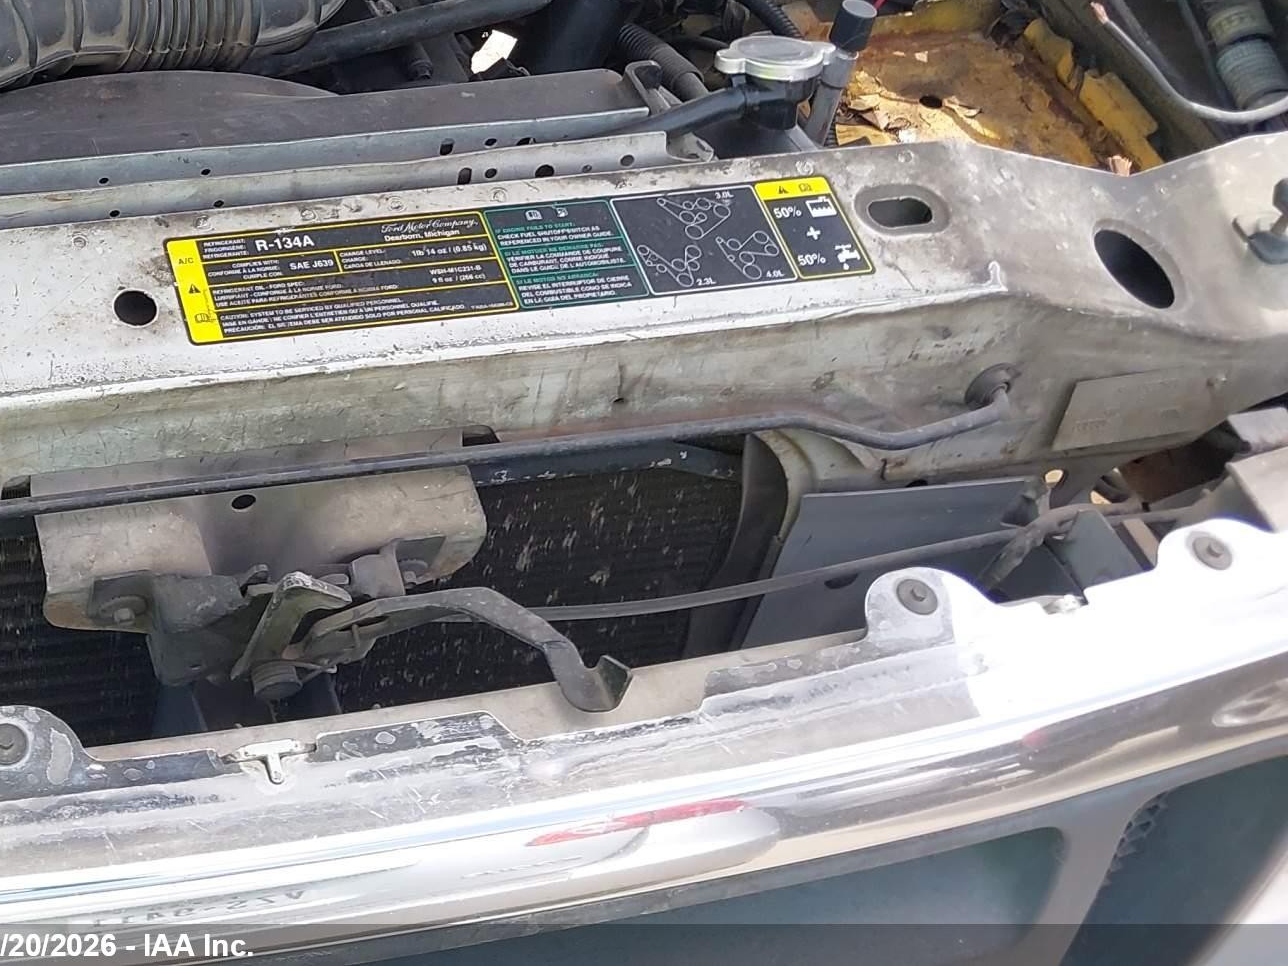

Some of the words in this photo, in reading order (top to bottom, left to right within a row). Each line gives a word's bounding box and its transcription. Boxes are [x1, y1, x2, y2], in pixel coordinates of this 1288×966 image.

[713, 191, 734, 199] 3.0L
[772, 205, 802, 218] 50%
[383, 232, 424, 242] Dearborn,
[423, 228, 460, 239] Michigan
[254, 234, 315, 251] R-134A
[425, 247, 436, 255] 14
[288, 261, 310, 270] SAE
[311, 259, 334, 268] J639
[796, 253, 827, 266] 50%
[764, 270, 784, 278] 4.0L
[695, 277, 717, 285] 2.3L
